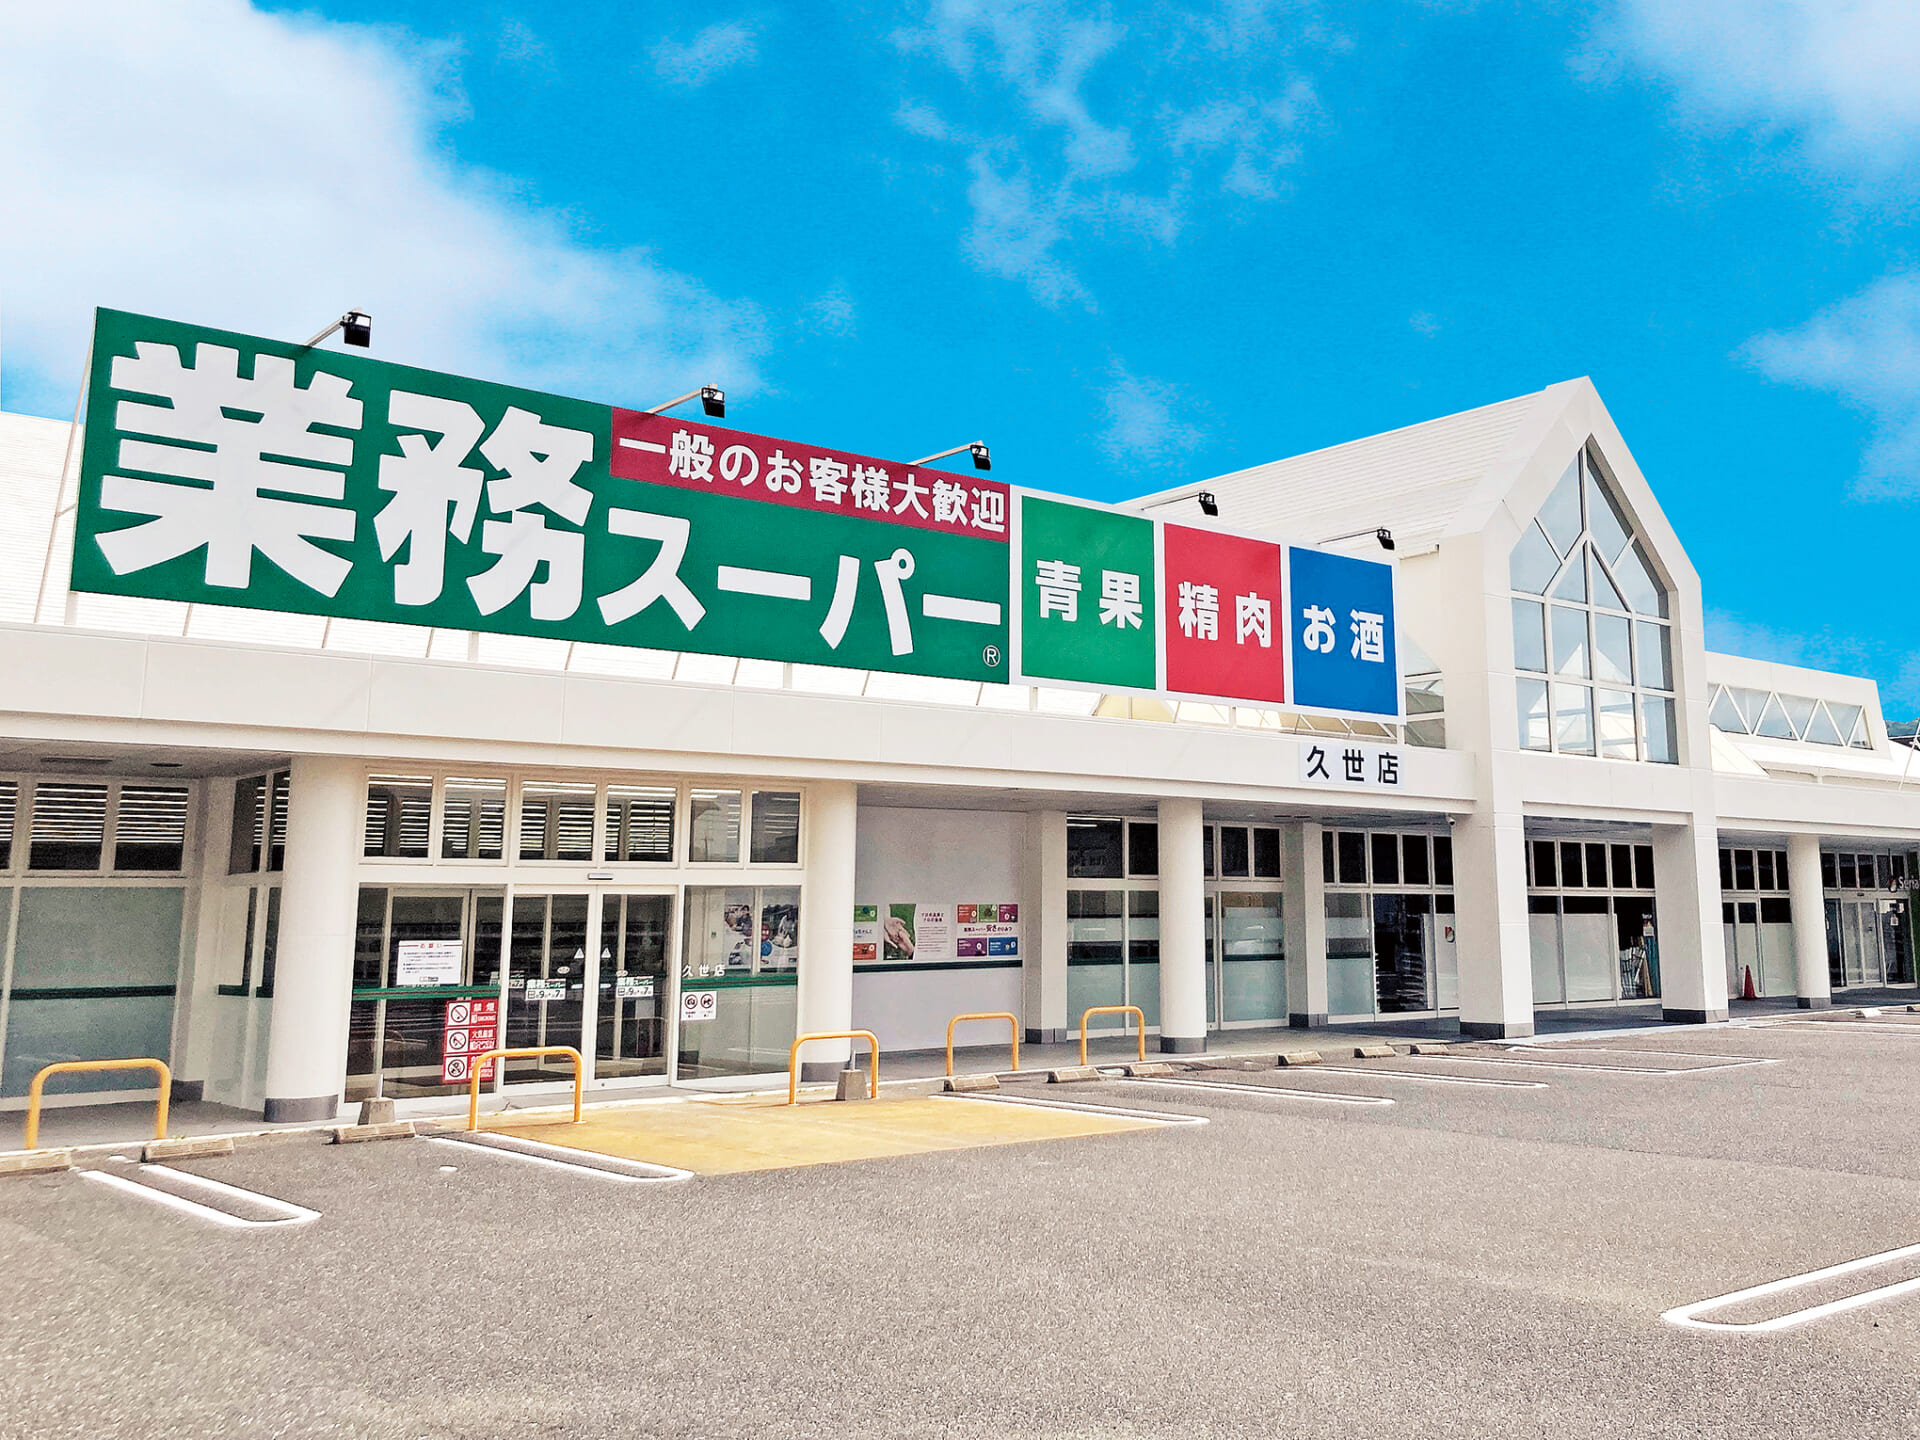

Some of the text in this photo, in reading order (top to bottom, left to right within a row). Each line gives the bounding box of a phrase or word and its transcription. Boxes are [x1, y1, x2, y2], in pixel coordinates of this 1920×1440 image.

[95, 342, 1002, 657] 業務スーパー
[619, 429, 1006, 533] 一般のお客様大歓迎
[1035, 560, 1143, 629] 青果
[1178, 581, 1272, 648] 精肉
[1303, 604, 1385, 664] お酒
[1307, 746, 1399, 785] 久世店
[682, 964, 726, 978] 久世店
